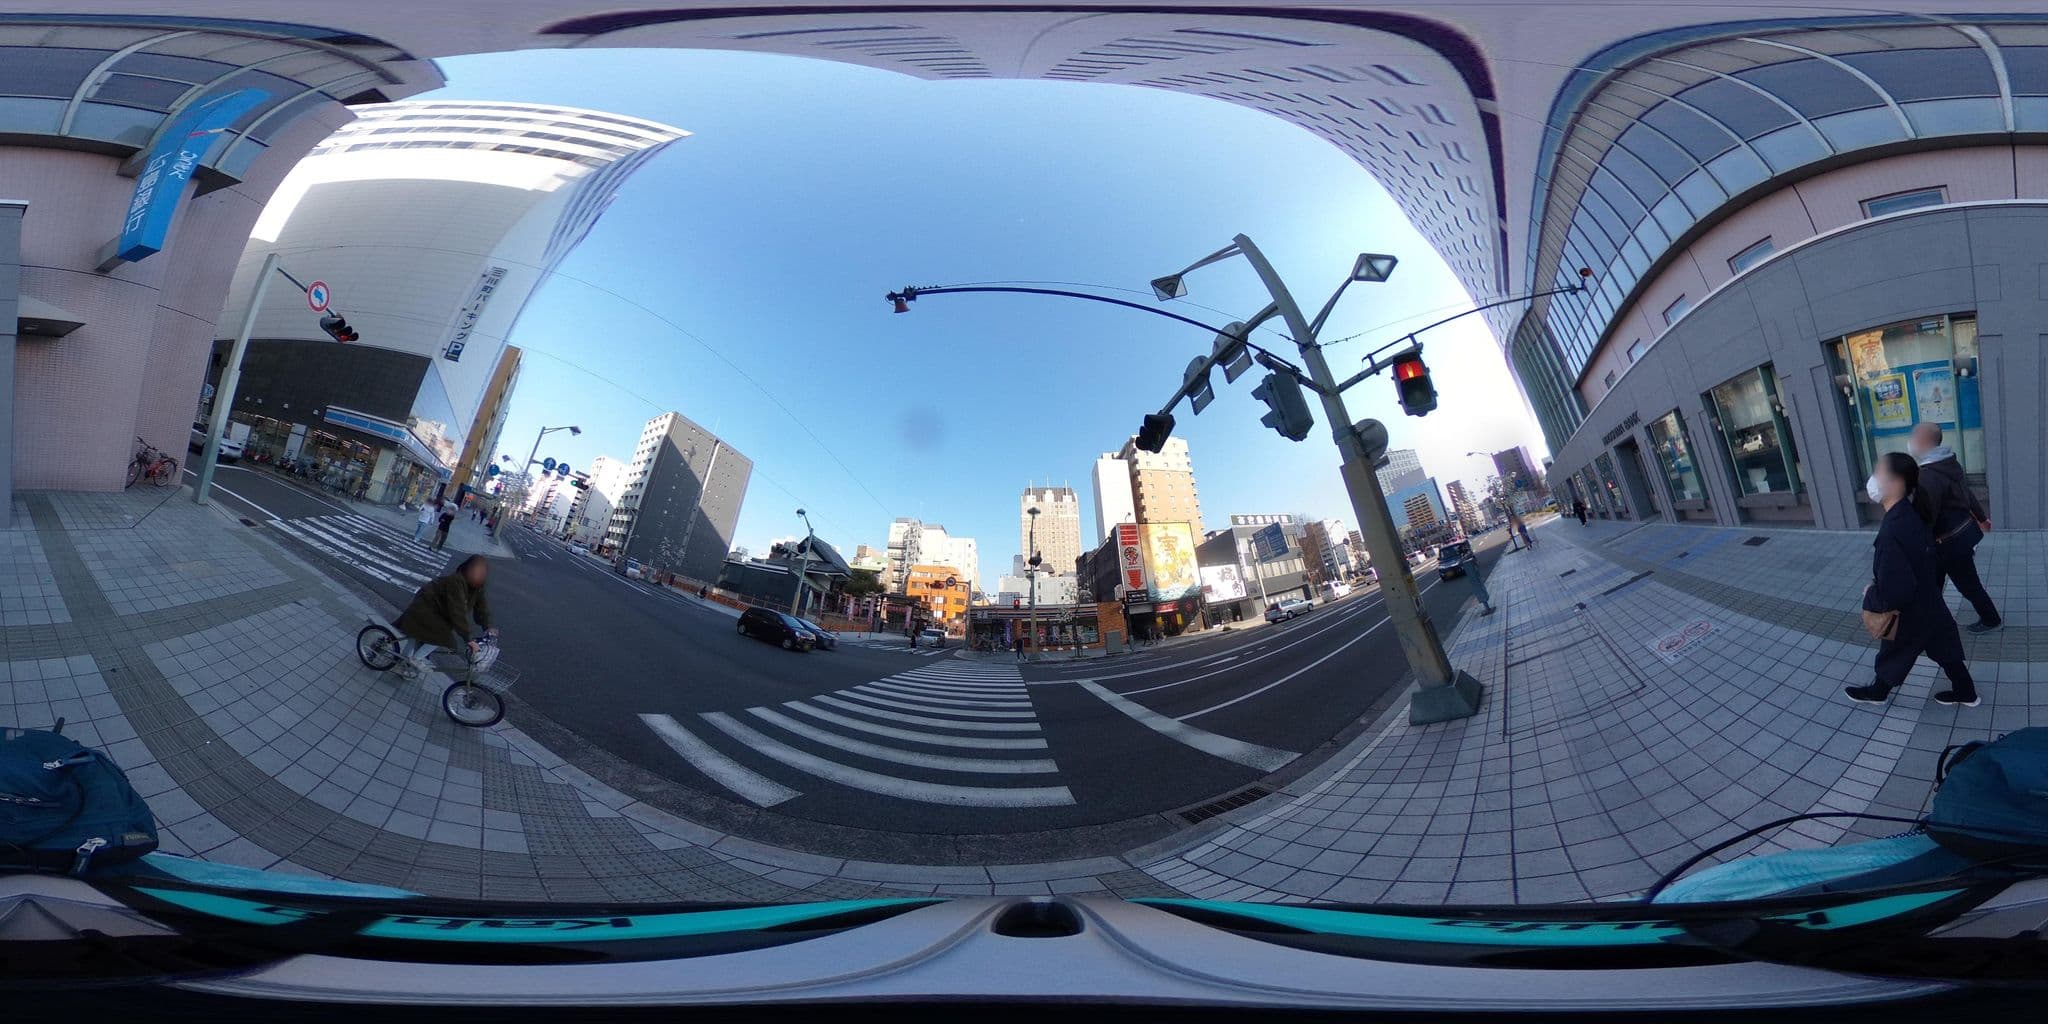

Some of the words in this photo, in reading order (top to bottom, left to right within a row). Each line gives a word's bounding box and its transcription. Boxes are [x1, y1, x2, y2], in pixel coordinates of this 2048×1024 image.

[456, 266, 508, 340] 三川町パーキング
